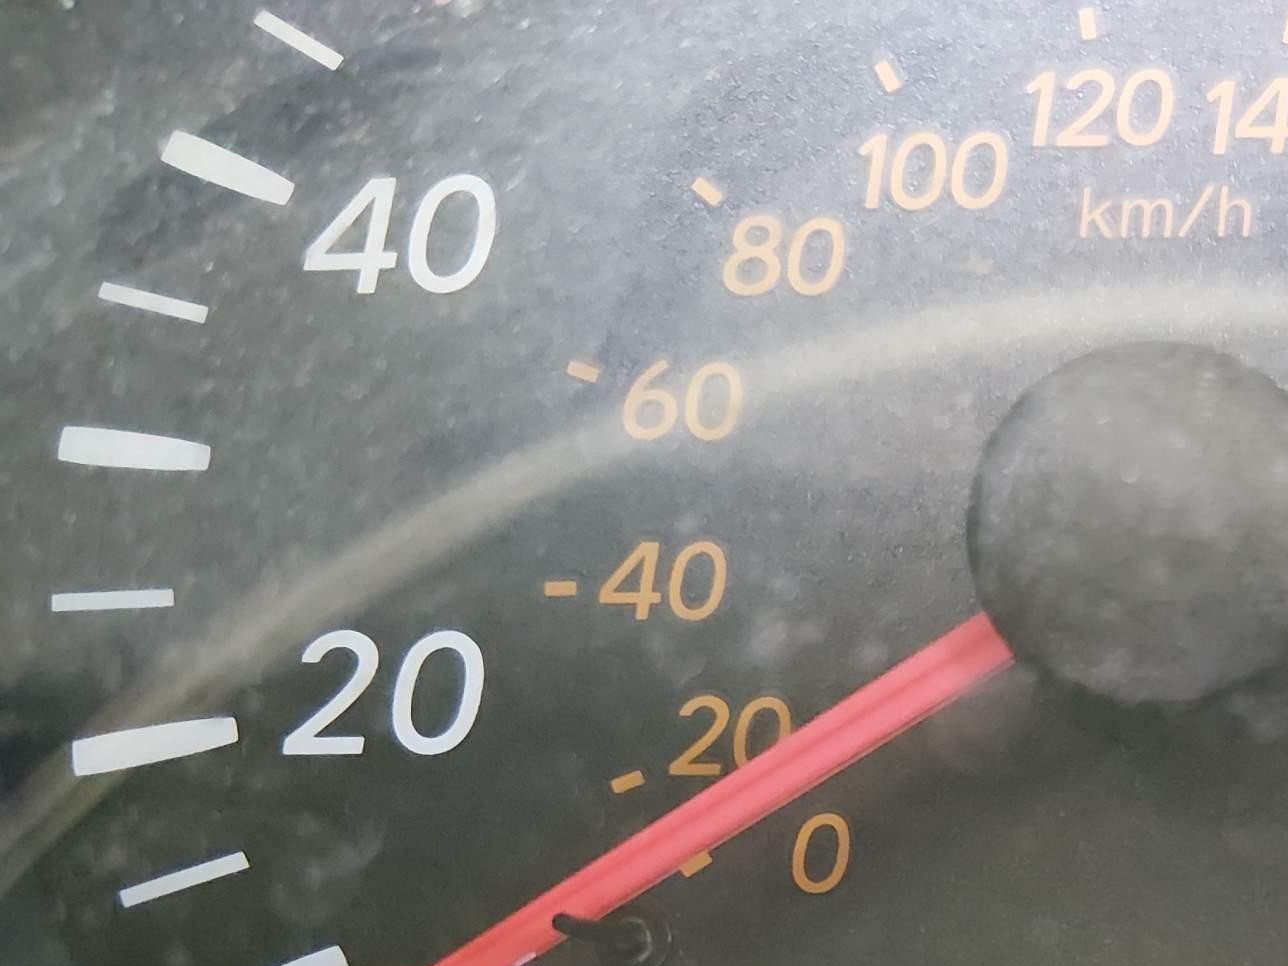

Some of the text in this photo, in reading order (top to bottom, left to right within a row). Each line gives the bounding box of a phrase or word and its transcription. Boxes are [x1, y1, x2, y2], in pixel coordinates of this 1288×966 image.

[1026, 69, 1175, 148] 120
[857, 131, 1009, 211] 100
[303, 174, 497, 295] 40
[1078, 186, 1253, 240] km/h
[722, 214, 845, 296] 80
[620, 360, 743, 441] 60
[599, 541, 728, 621] 40
[281, 629, 485, 756] 20
[668, 694, 793, 775] 20
[792, 812, 851, 894] 0
